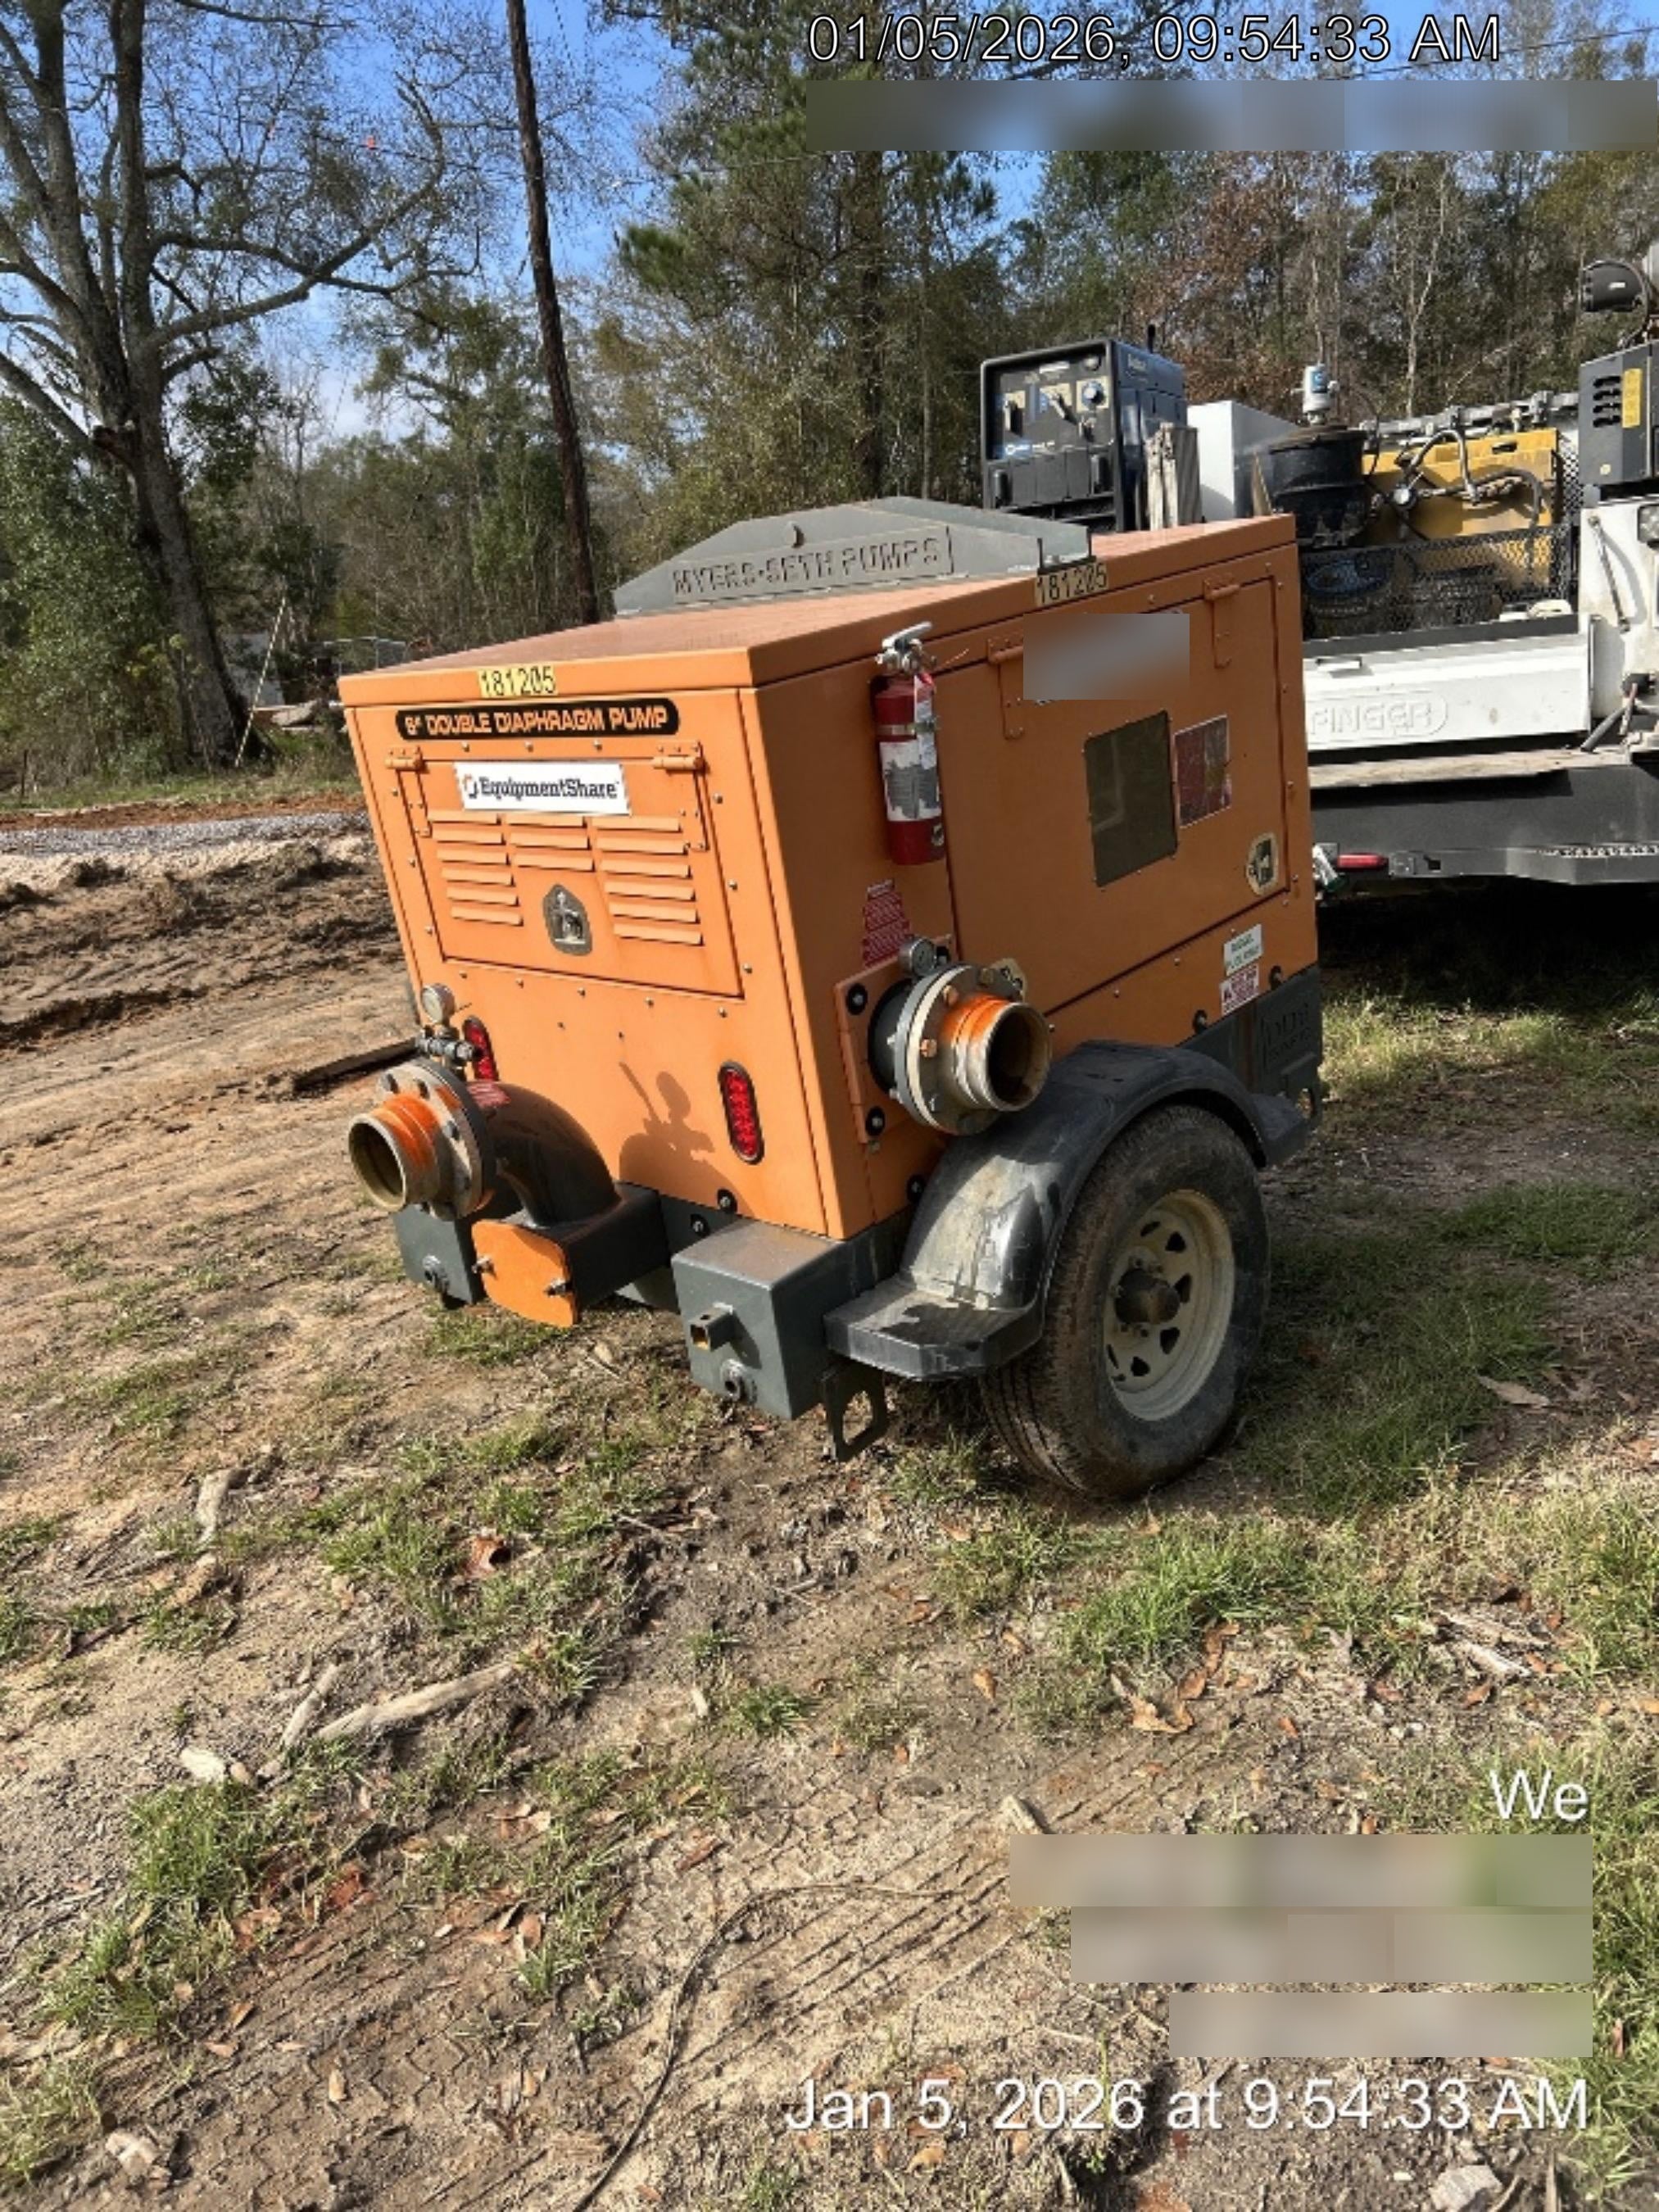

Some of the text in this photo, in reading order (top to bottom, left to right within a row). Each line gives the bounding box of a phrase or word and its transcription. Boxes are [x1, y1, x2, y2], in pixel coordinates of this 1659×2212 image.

[841, 537, 939, 576] PUMPS
[1036, 561, 1107, 604] 181205
[480, 665, 555, 696] 181205
[425, 712, 492, 735] DOUBLE
[493, 708, 605, 734] DIAPHRAGM
[607, 705, 668, 732] PUMP
[478, 776, 617, 800] EquipmentShare
